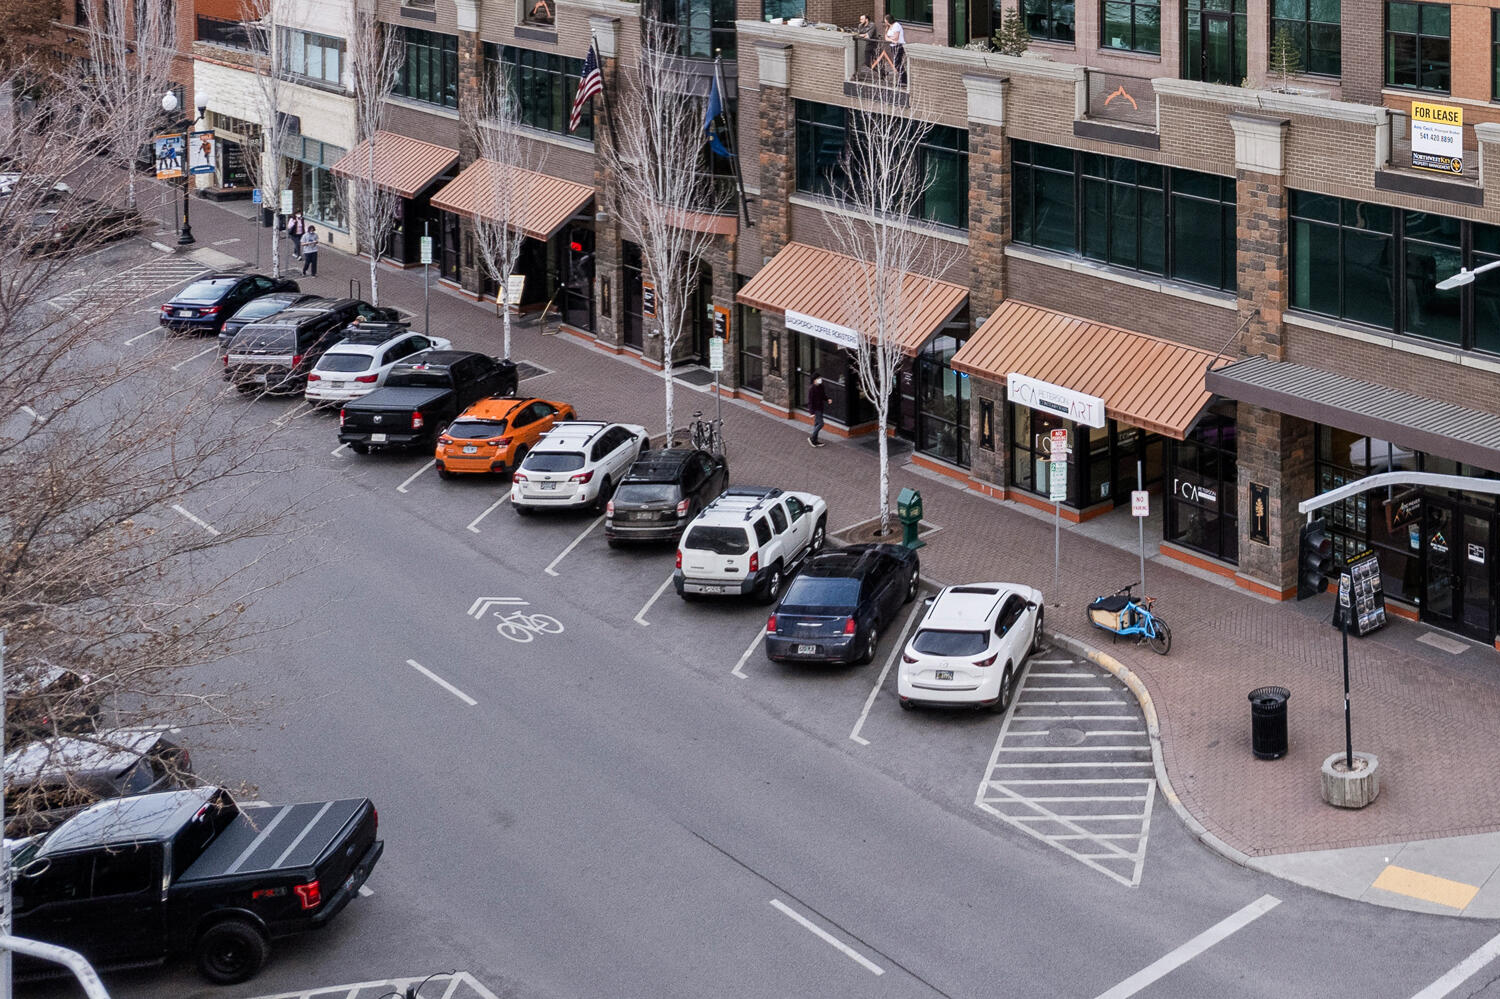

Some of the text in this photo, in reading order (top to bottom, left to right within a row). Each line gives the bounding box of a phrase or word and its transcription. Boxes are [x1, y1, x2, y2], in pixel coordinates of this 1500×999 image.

[1415, 106, 1458, 122] FOR LEASE
[1070, 400, 1093, 422] ART
